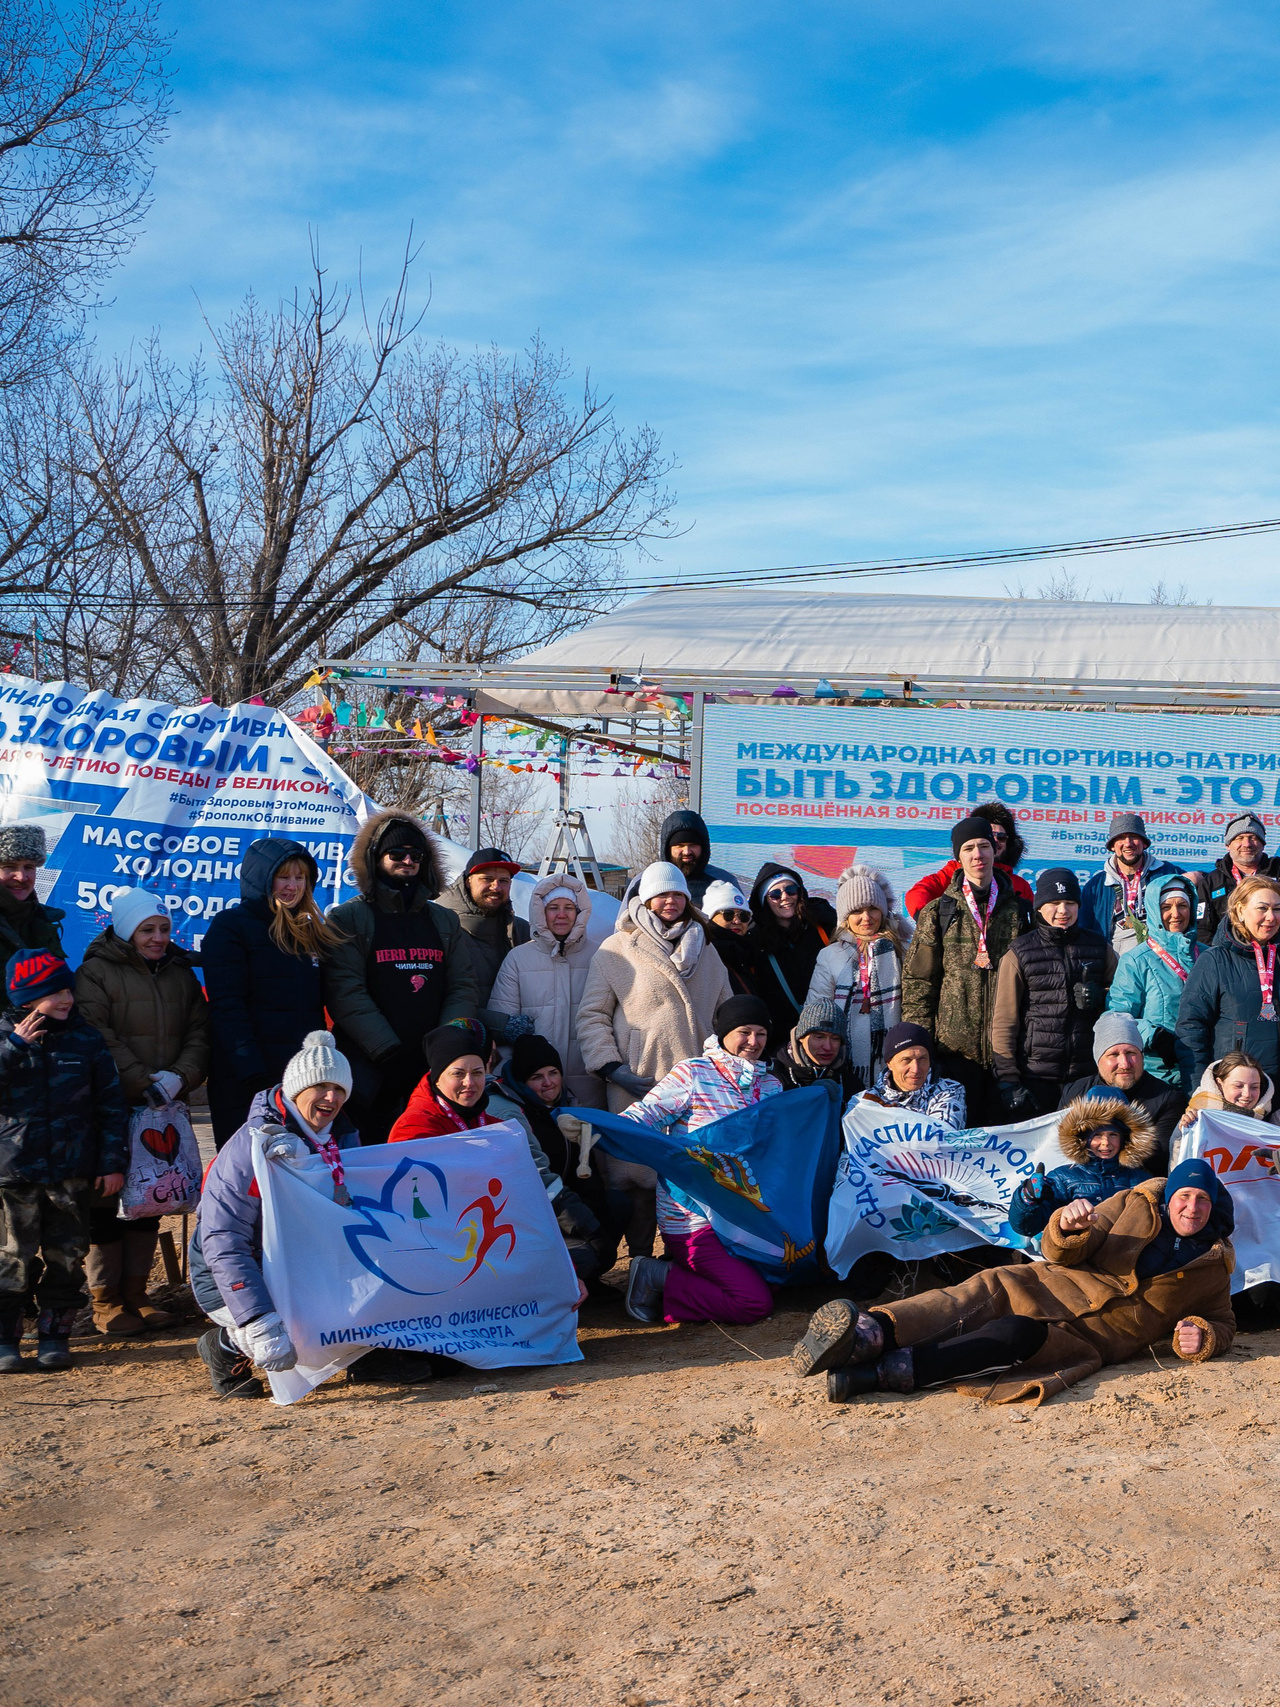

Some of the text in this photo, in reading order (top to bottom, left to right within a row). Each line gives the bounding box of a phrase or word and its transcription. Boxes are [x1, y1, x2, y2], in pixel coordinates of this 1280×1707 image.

[10, 714, 269, 773] ЗДОРОВЫМ
[737, 742, 996, 767] МЕЖДУНАРОДНАЯ
[125, 764, 211, 789] ПОБЕДЫ
[215, 777, 228, 790] В
[232, 776, 330, 796] ВЕЛИКОЙ
[735, 767, 861, 800] БЫТЬ
[869, 769, 1143, 806] ЗДОРОВЫМ
[1175, 775, 1264, 806] ЭТО
[188, 809, 326, 827] #ЯрополкОбливание
[735, 801, 890, 820] ПОСВЯЩЁННАЯ
[895, 806, 972, 820] 80-ЛЕТ
[1094, 810, 1107, 823] В
[82, 825, 241, 856] МАССОВОЕ
[376, 948, 444, 963] HERR PEPPER
[984, 1134, 1040, 1182] МОР
[137, 1166, 150, 1182] I
[152, 1166, 182, 1178] Love
[920, 1151, 1011, 1204] АСТРАХАН
[152, 1177, 201, 1203] Coffee
[320, 1300, 540, 1347] МИНИСТЕРСТВО ФИЗИЧЕСКОЙ
[462, 1325, 515, 1340] СПОРТА
